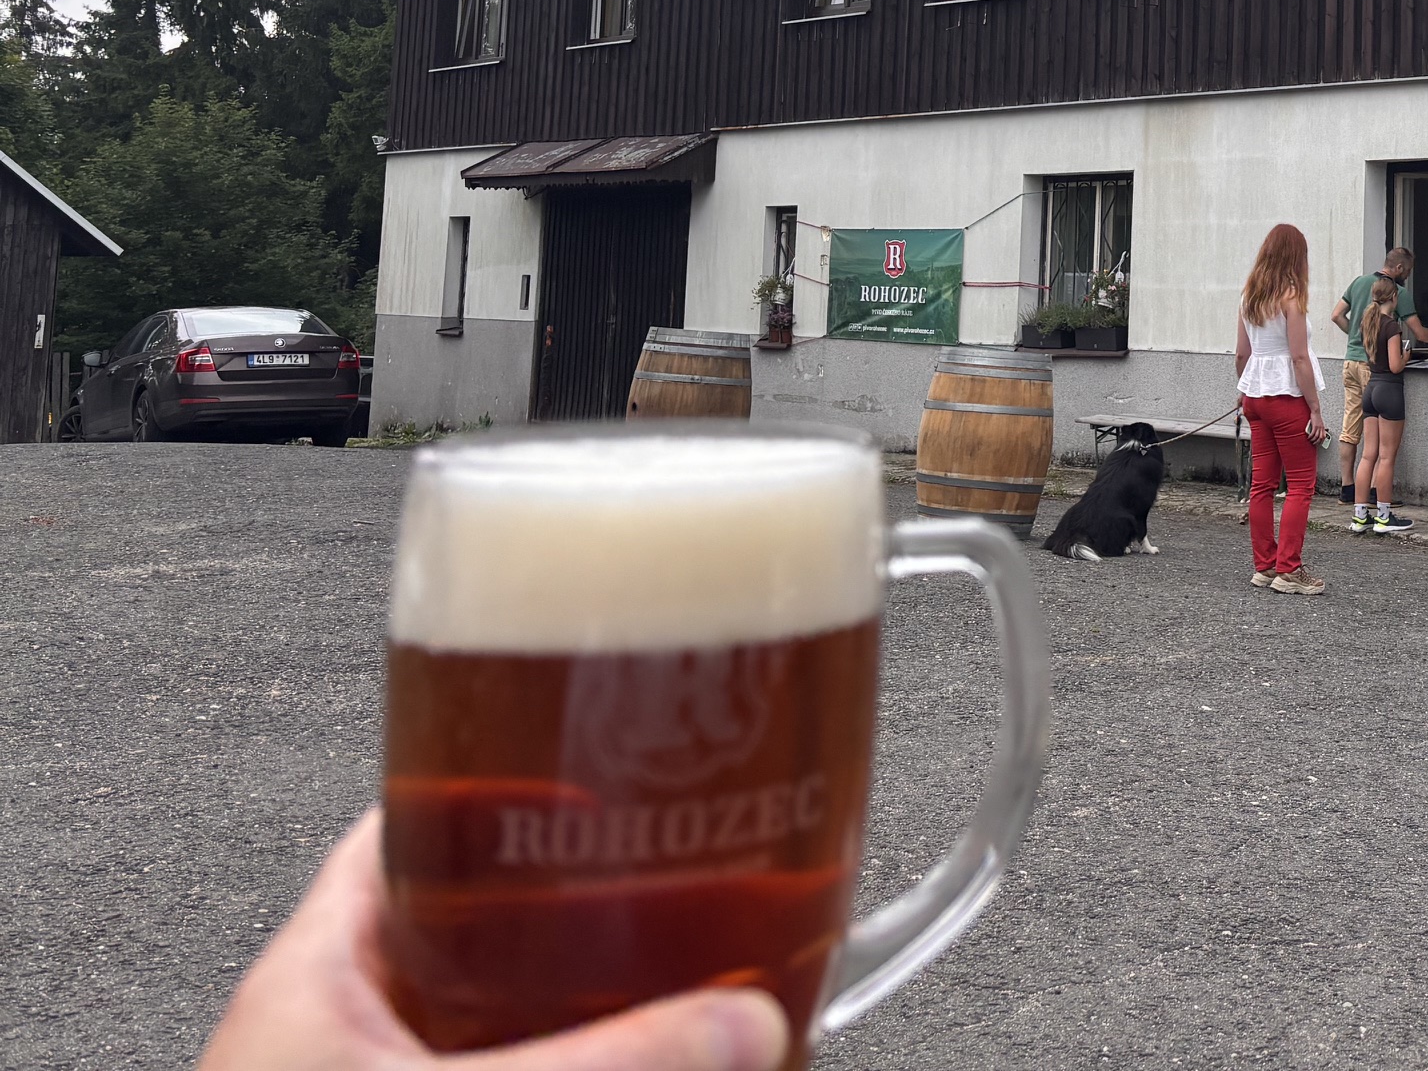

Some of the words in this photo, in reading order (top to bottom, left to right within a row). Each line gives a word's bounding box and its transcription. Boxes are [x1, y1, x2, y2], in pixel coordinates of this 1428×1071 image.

[887, 244, 902, 269] R
[860, 285, 927, 304] ROHOZEC
[256, 354, 274, 364] 4L9
[281, 354, 305, 364] 7121
[496, 772, 826, 867] ROHOZEC
